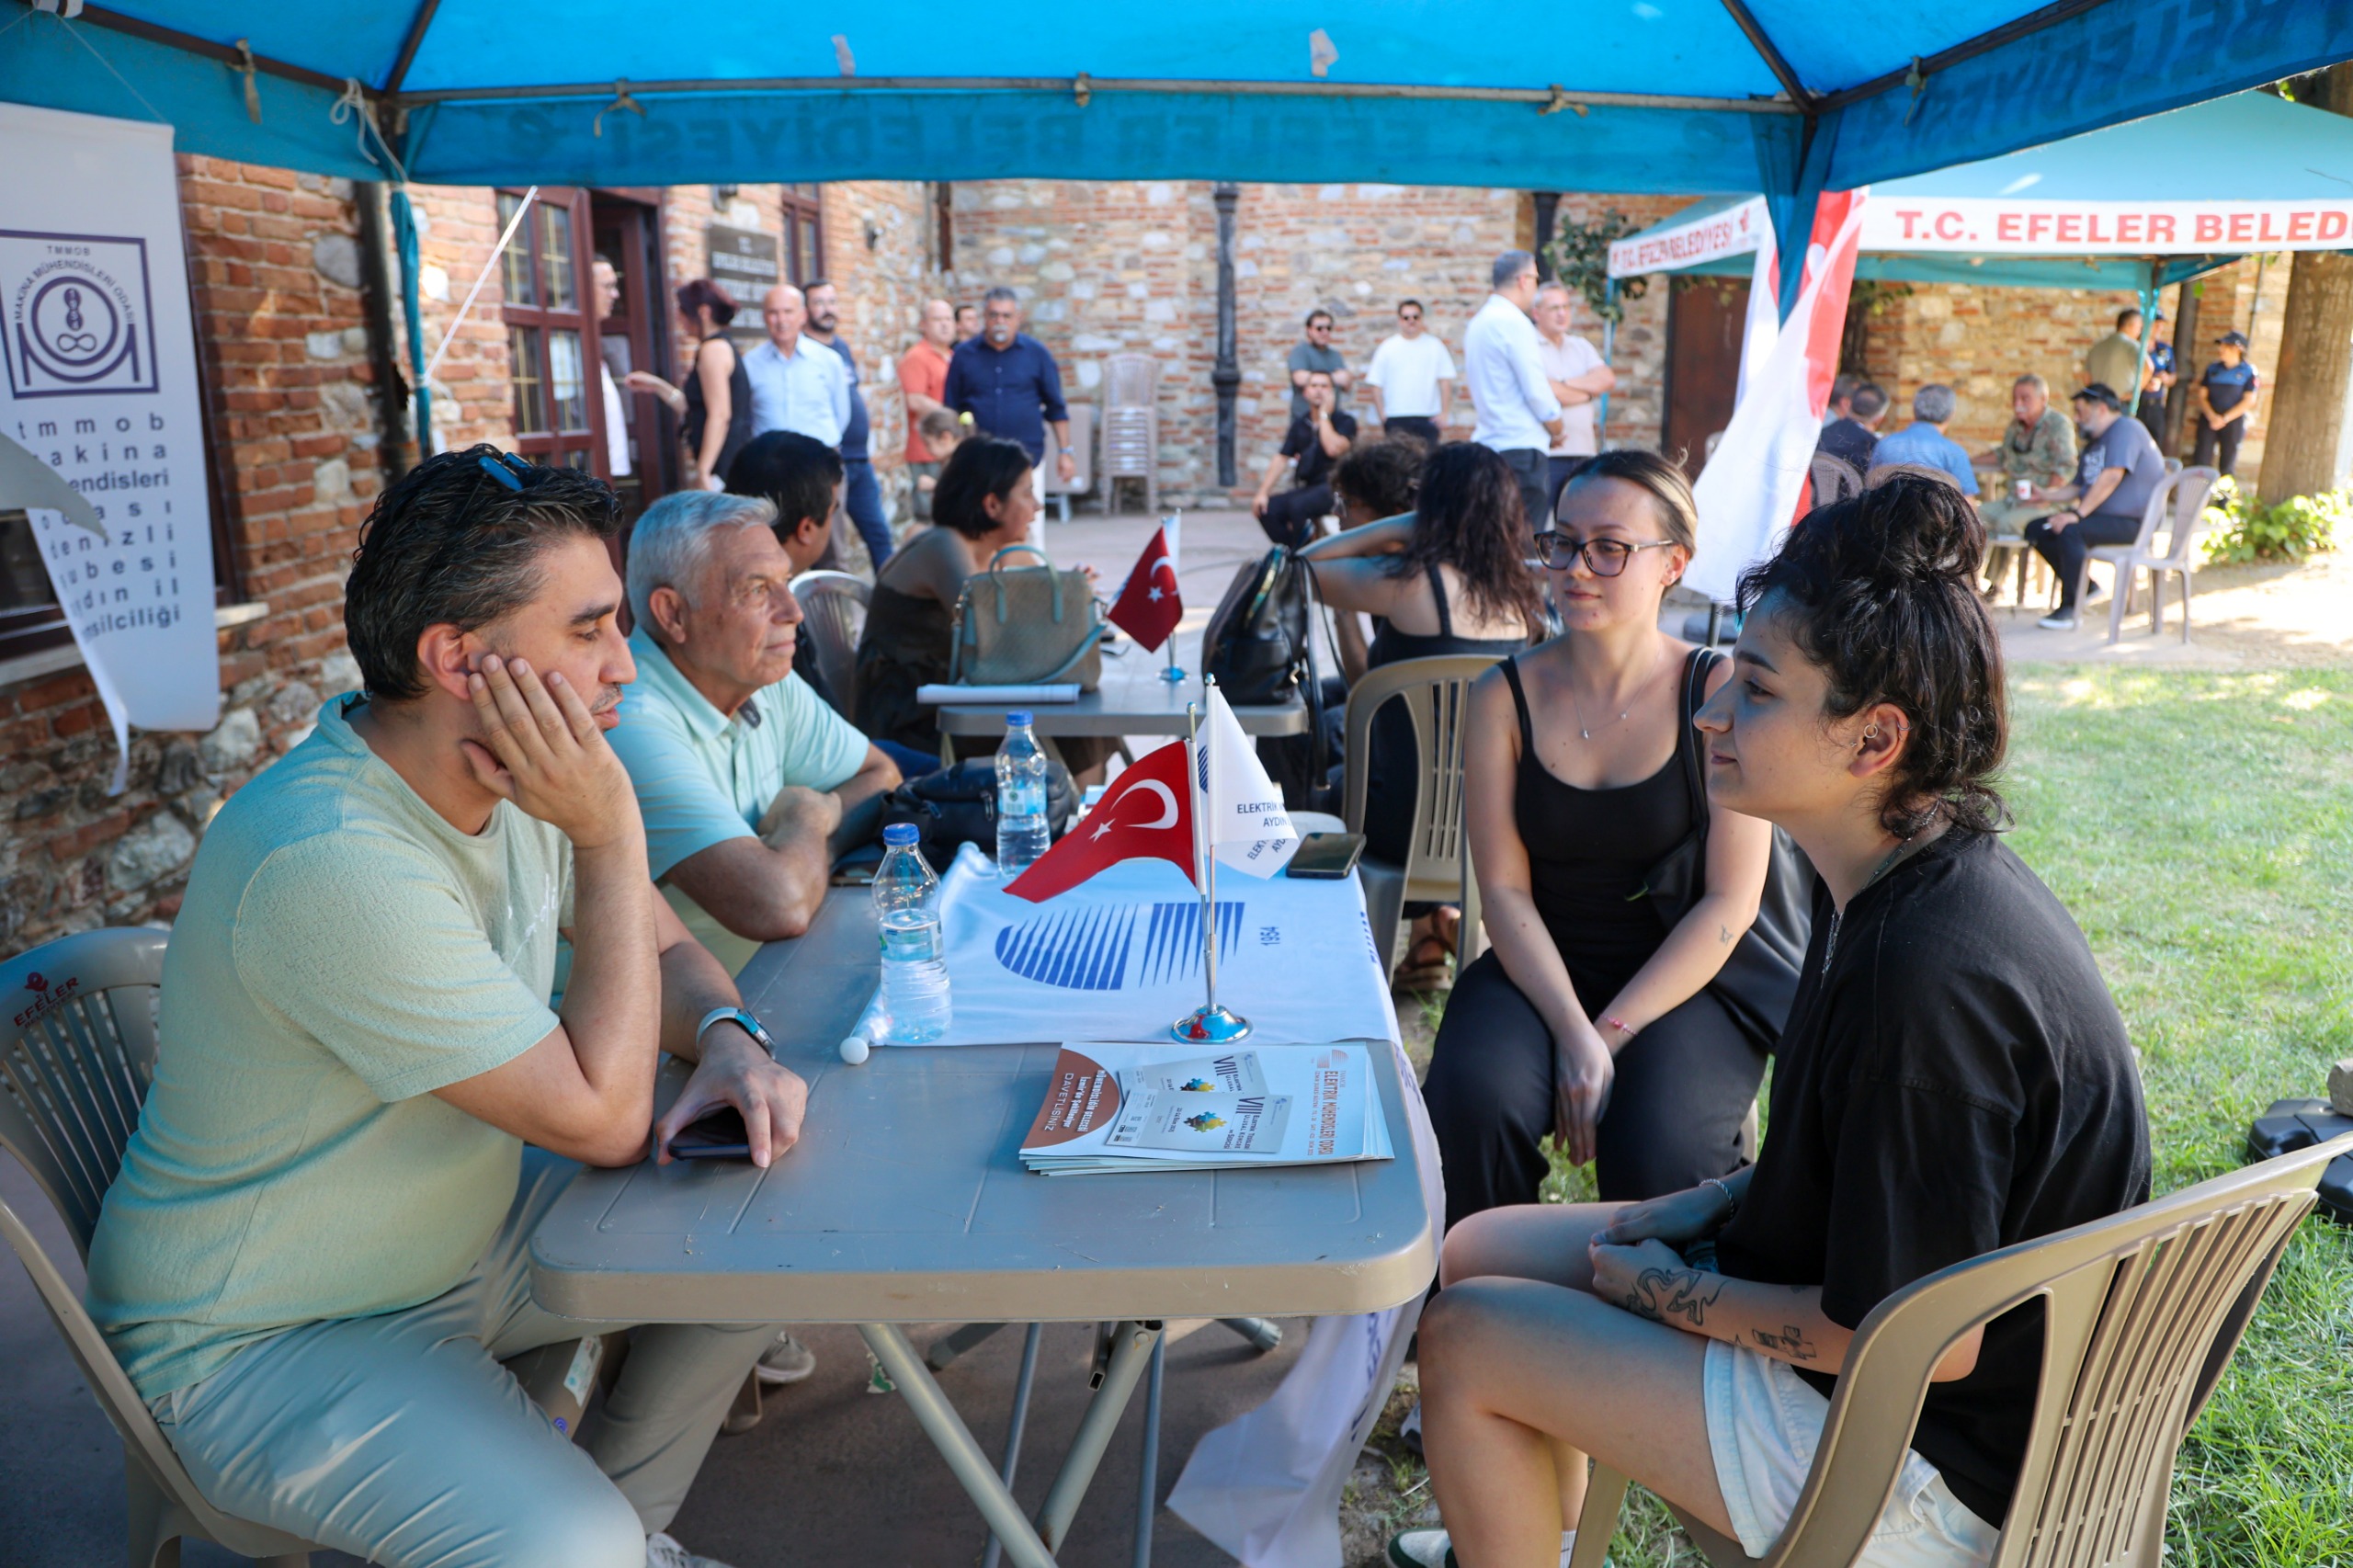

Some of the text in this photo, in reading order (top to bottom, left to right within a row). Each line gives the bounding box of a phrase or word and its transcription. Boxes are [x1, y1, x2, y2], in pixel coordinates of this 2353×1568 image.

[1895, 211, 2353, 243] T.C. EFELER BELED
[47, 245, 90, 256] TMMOB
[33, 442, 167, 467] akina
[69, 468, 169, 493] endisleri
[1259, 926, 1280, 946] 1954
[14, 977, 79, 1027] EFELER
[1235, 1096, 1265, 1114] VIII
[1318, 1071, 1339, 1155] ELEKTRİK MÜHENDİSLERİ ODASI
